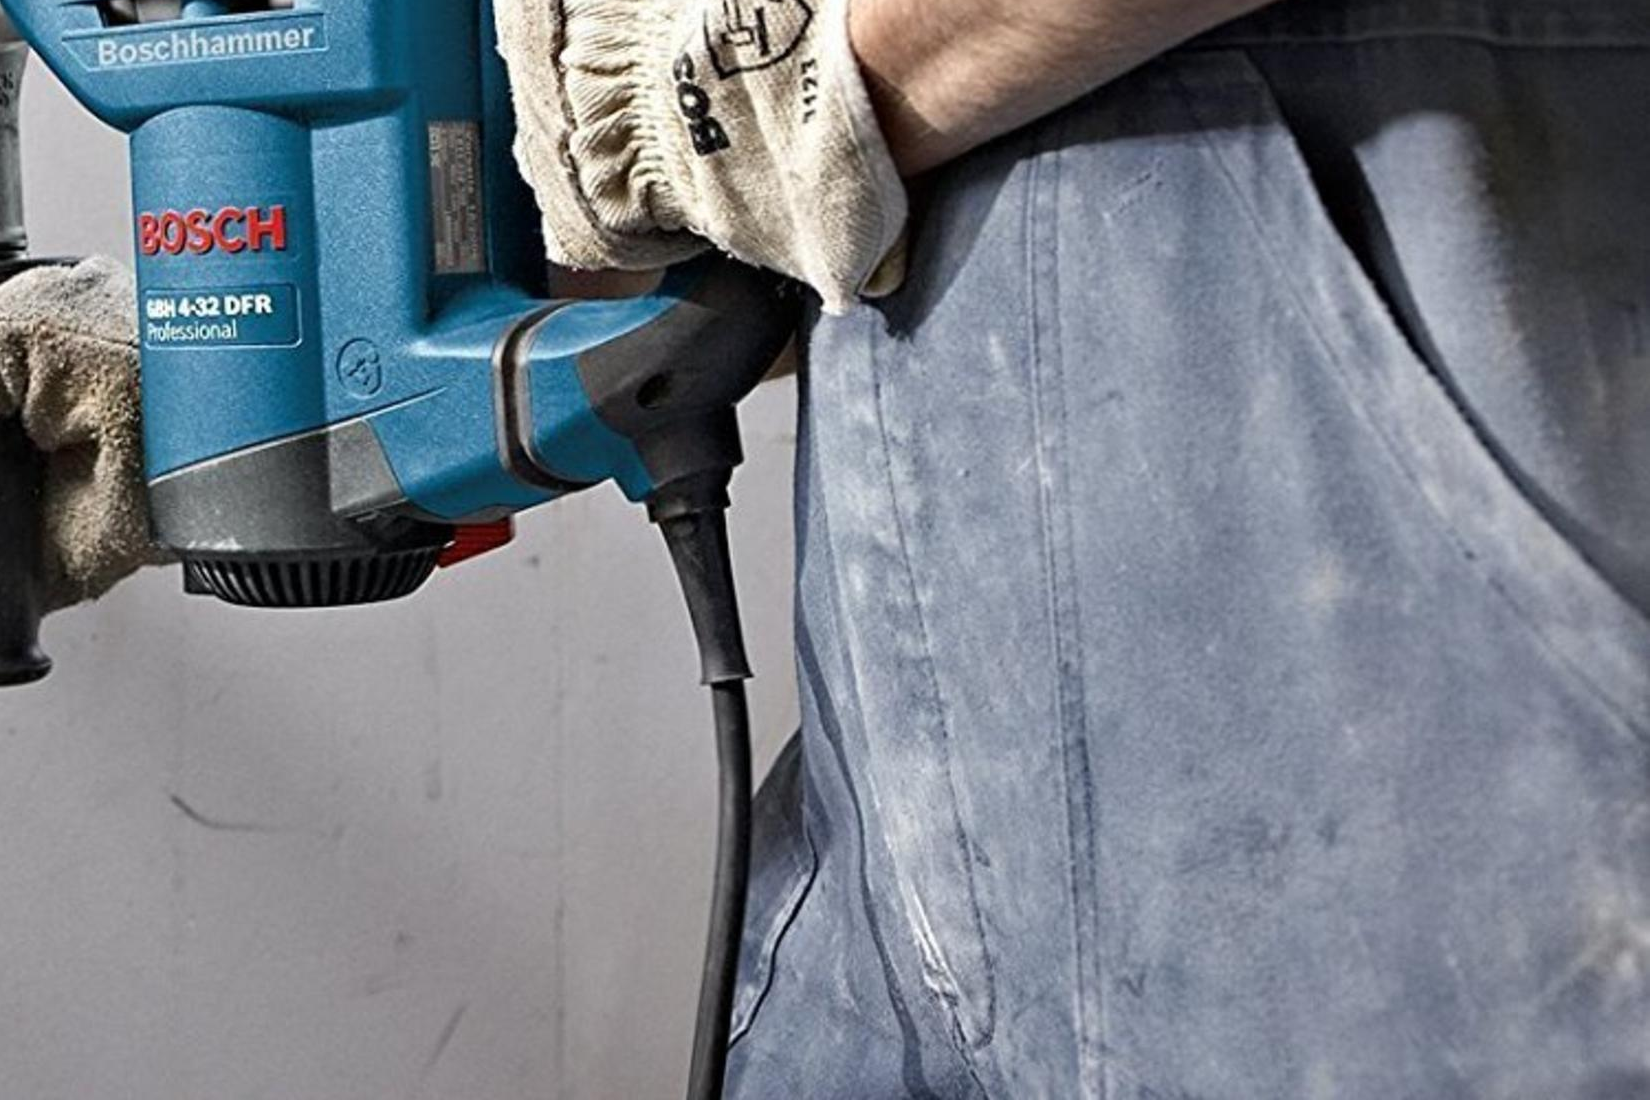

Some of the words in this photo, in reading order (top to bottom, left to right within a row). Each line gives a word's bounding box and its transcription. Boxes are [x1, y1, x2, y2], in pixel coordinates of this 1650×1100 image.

[99, 26, 314, 65] Boschhammer
[138, 204, 286, 255] BOSCH
[146, 298, 176, 318] GBH
[178, 296, 220, 318] 4-32
[224, 294, 273, 316] DFR
[147, 319, 238, 342] Professional
